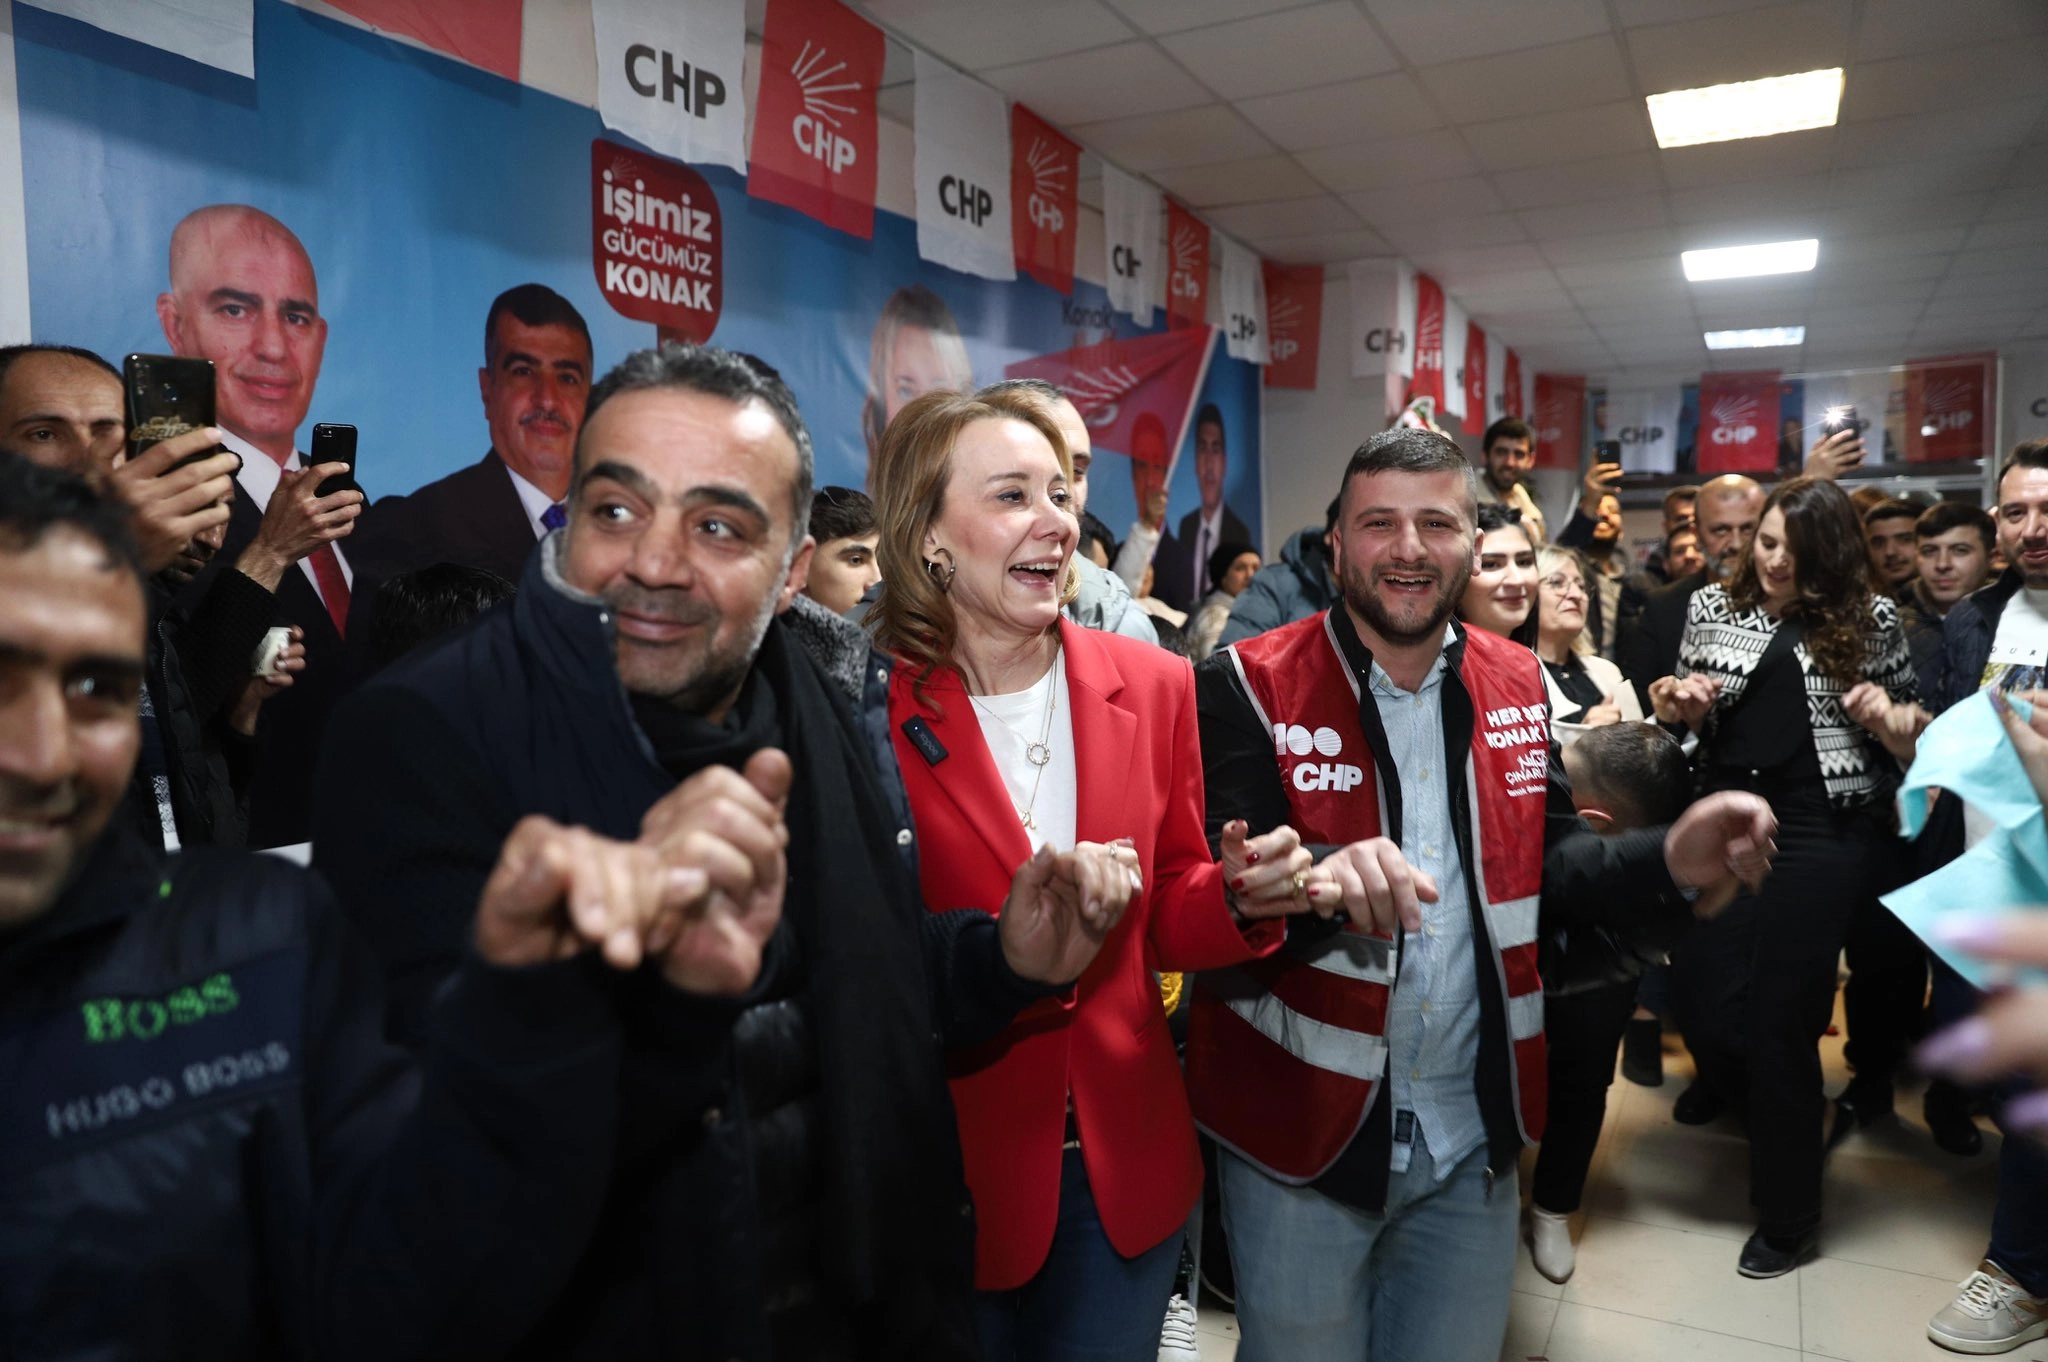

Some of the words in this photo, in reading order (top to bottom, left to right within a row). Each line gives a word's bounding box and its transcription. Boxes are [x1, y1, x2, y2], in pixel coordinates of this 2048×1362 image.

[624, 43, 727, 120] CHP
[792, 113, 857, 175] CHP
[602, 168, 713, 243] işimiz
[938, 173, 994, 228] CHP
[602, 226, 713, 276] GÜCÜMÜZ
[605, 259, 713, 312] KONAK
[1269, 339, 1300, 360] HP
[1365, 328, 1406, 353] CH
[1619, 426, 1664, 444] CHP
[1711, 425, 1758, 444] CHP
[1485, 706, 1524, 728] HER
[1273, 722, 1343, 757] 100
[1484, 725, 1544, 749] KONAK
[1293, 762, 1364, 793] CHP
[46, 1076, 177, 1138] HUGO
[182, 1040, 291, 1096] BOSS
